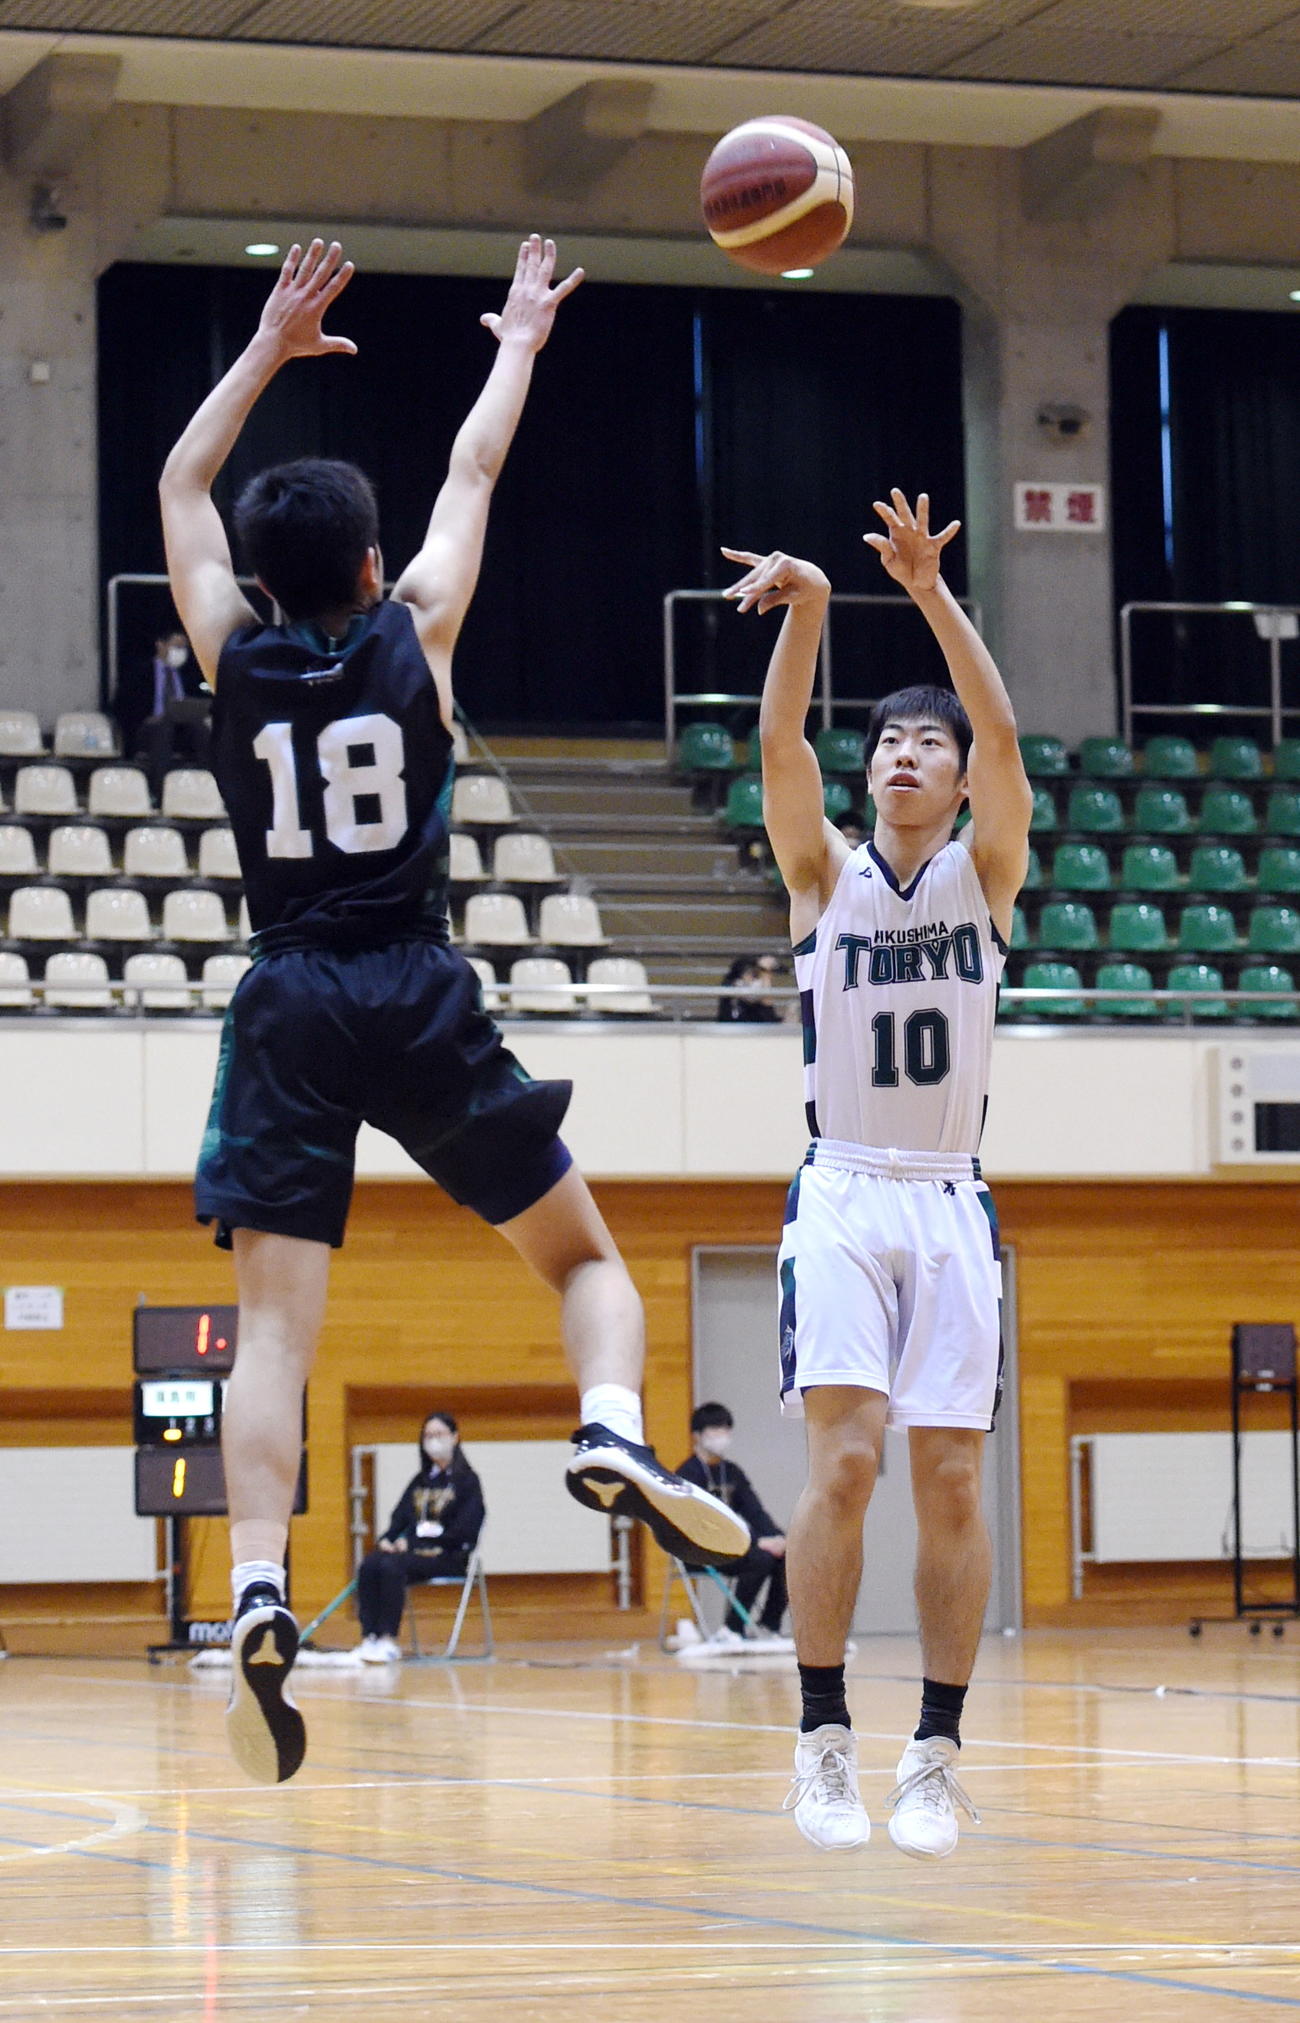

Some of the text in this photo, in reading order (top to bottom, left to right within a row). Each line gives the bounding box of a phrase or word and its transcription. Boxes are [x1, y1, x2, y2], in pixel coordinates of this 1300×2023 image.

[253, 713, 408, 858] 18
[835, 922, 984, 992] TORYO
[872, 1008, 950, 1087] 10
[173, 1457, 186, 1498] 1
